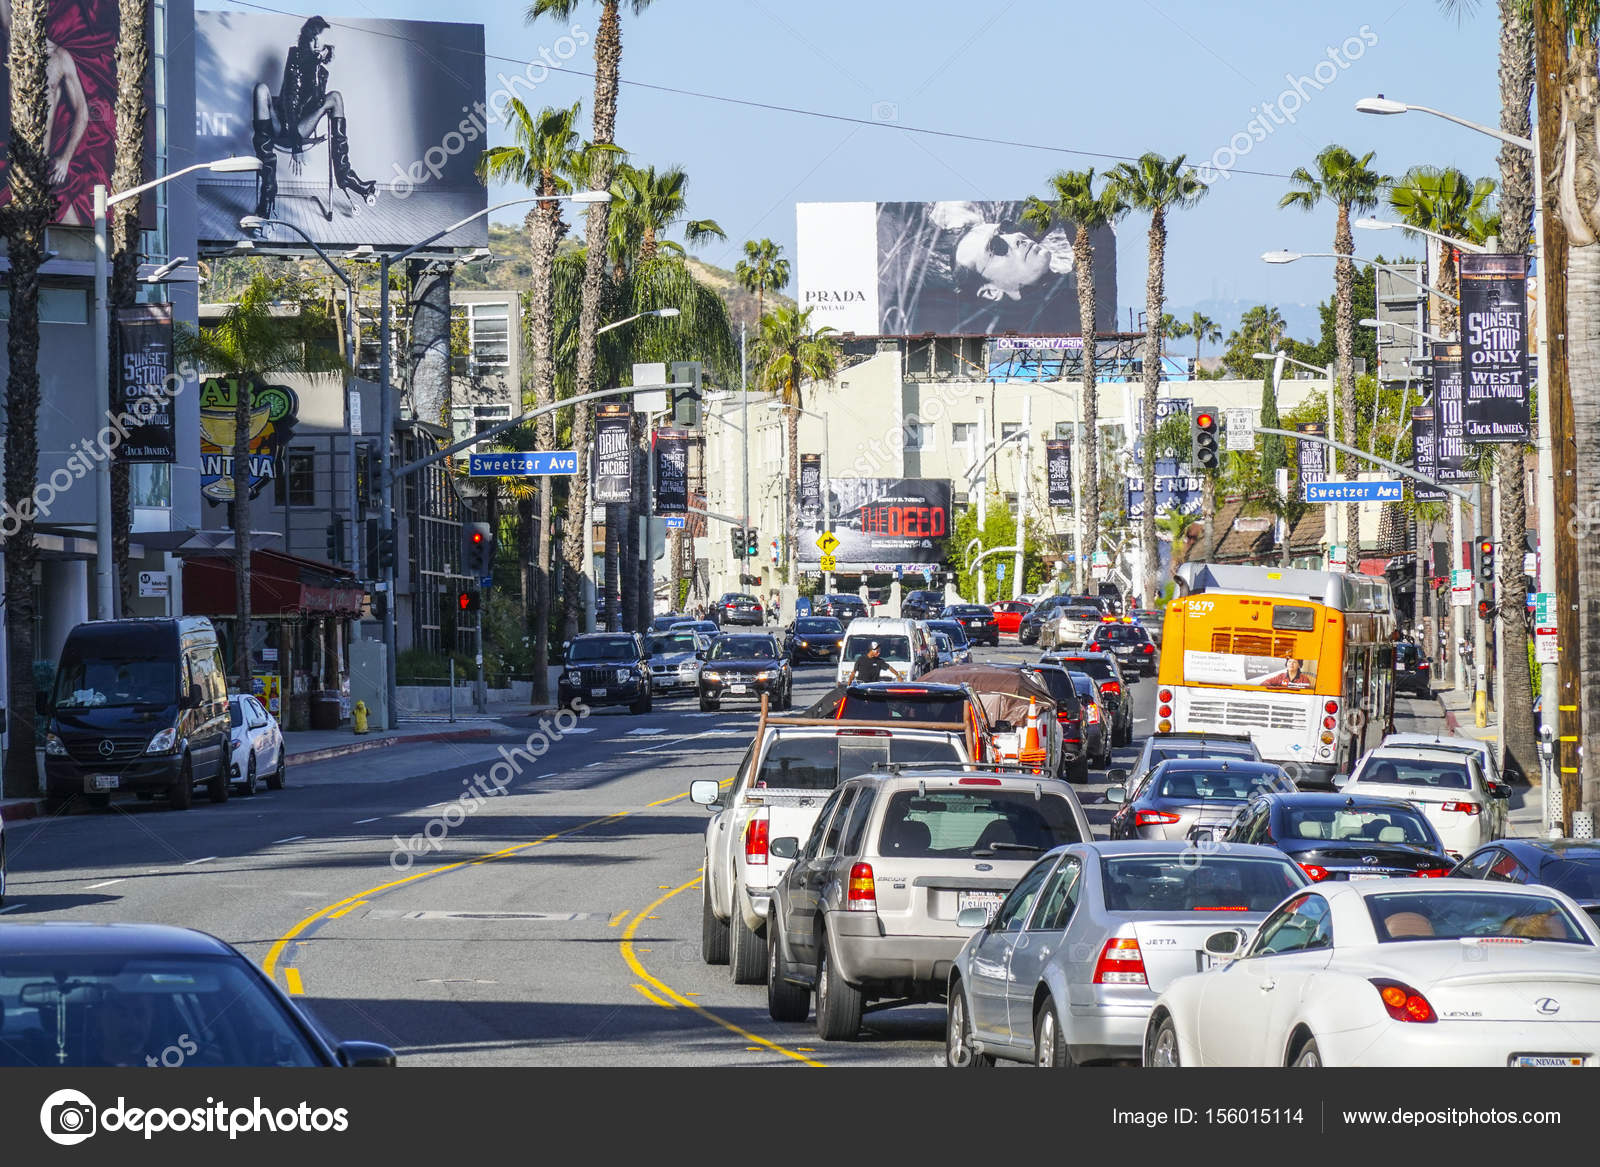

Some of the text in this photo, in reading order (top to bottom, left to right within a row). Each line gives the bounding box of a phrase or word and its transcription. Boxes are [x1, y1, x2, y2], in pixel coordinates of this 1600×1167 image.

[805, 290, 866, 302] PRADA
[1468, 312, 1522, 345] SUNSET
[1000, 339, 1083, 349] OUTFRONT/PRIM
[1483, 328, 1521, 350] STRIP
[1471, 351, 1521, 363] ONLY
[124, 352, 168, 381] SUNSET
[1471, 371, 1523, 384] WEST
[1469, 385, 1523, 398] HOLLYWOOD
[1470, 422, 1491, 434] JACK
[599, 433, 629, 455] DRINK
[1302, 450, 1322, 464] ROCK
[474, 457, 575, 471] Sweetzer Ave
[600, 461, 629, 475] ENCORE
[1129, 478, 1162, 491] LIE
[1310, 485, 1400, 498] Sweetzer Ave
[888, 506, 945, 537] DEED
[823, 557, 835, 566] 25
[1188, 601, 1215, 612] 5679
[1536, 1058, 1567, 1067] NEVADA
